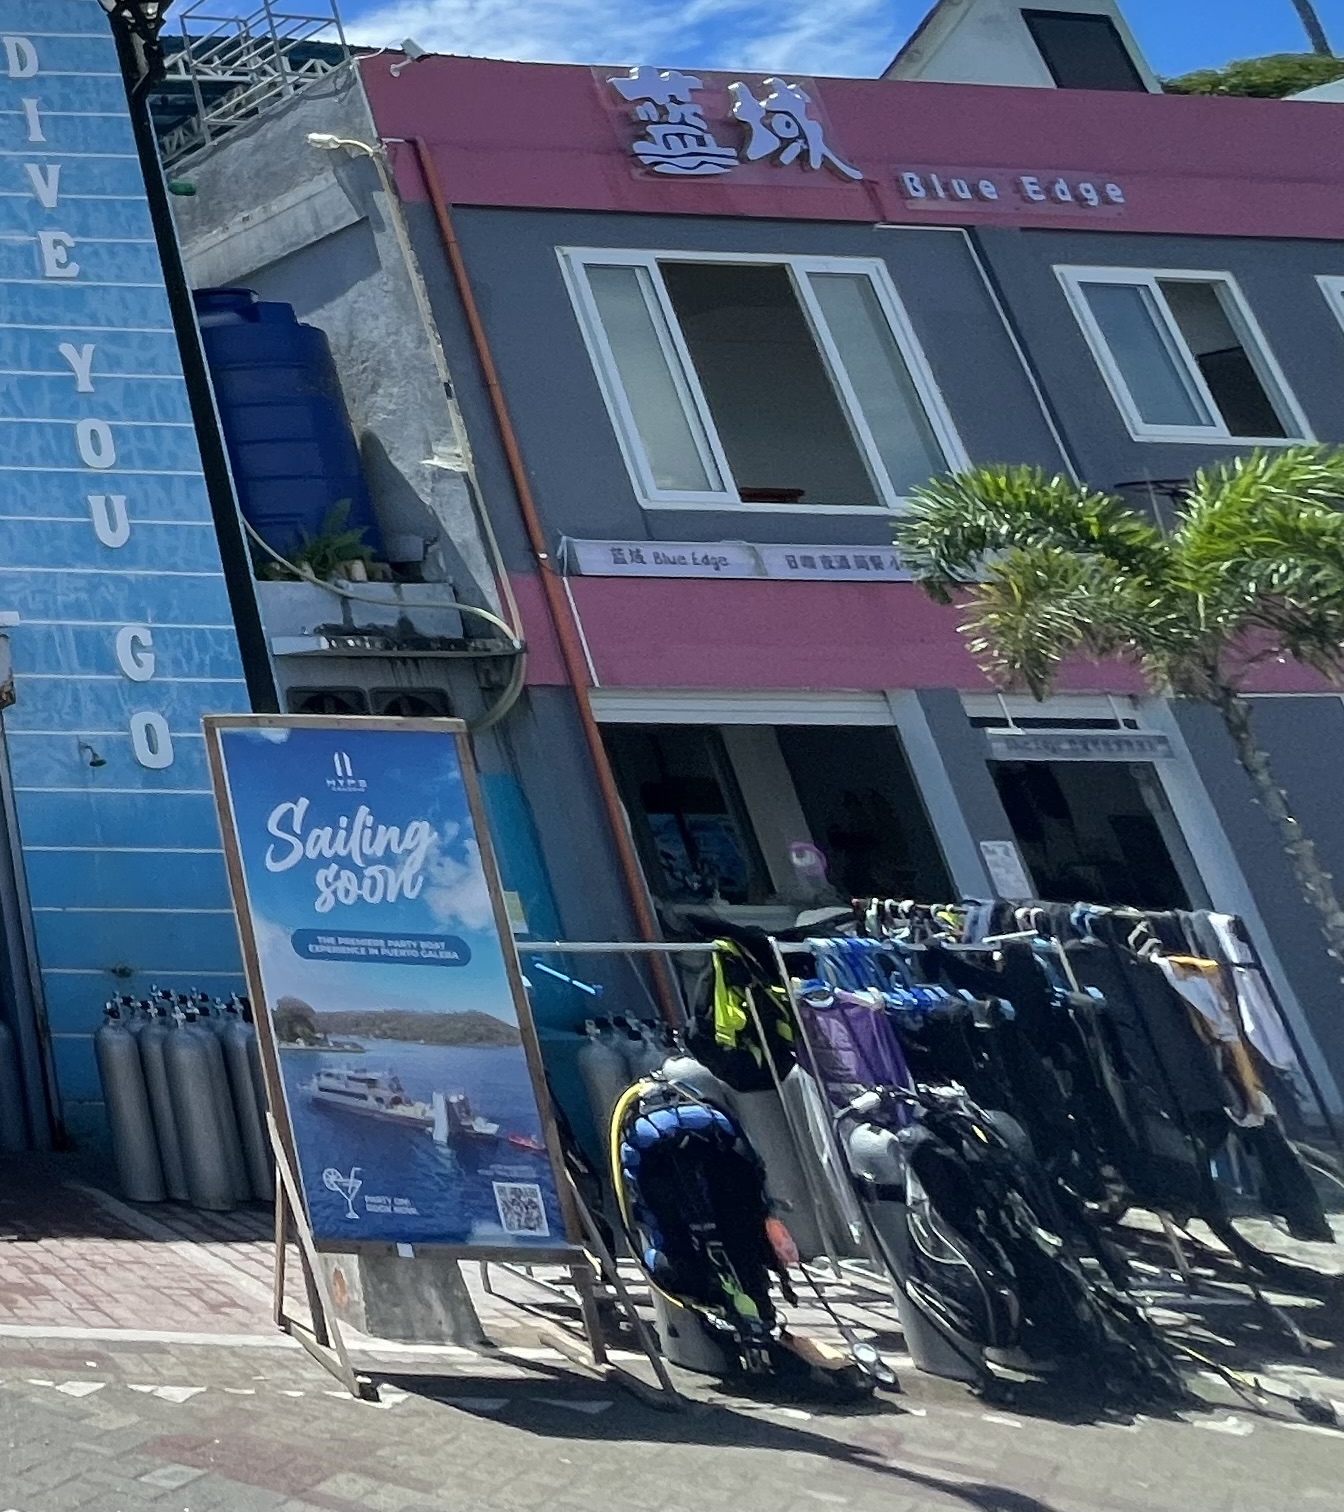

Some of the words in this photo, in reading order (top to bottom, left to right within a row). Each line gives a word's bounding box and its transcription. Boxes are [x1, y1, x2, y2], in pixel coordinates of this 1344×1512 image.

[901, 171, 1000, 201] Blue
[1018, 174, 1126, 207] Edge
[2, 37, 79, 277] DIVE
[59, 343, 130, 548] YOU
[116, 626, 174, 769] GO
[653, 551, 688, 566] Blue
[692, 552, 729, 571] Edge
[265, 797, 438, 876] Sailing
[315, 863, 424, 913] soon
